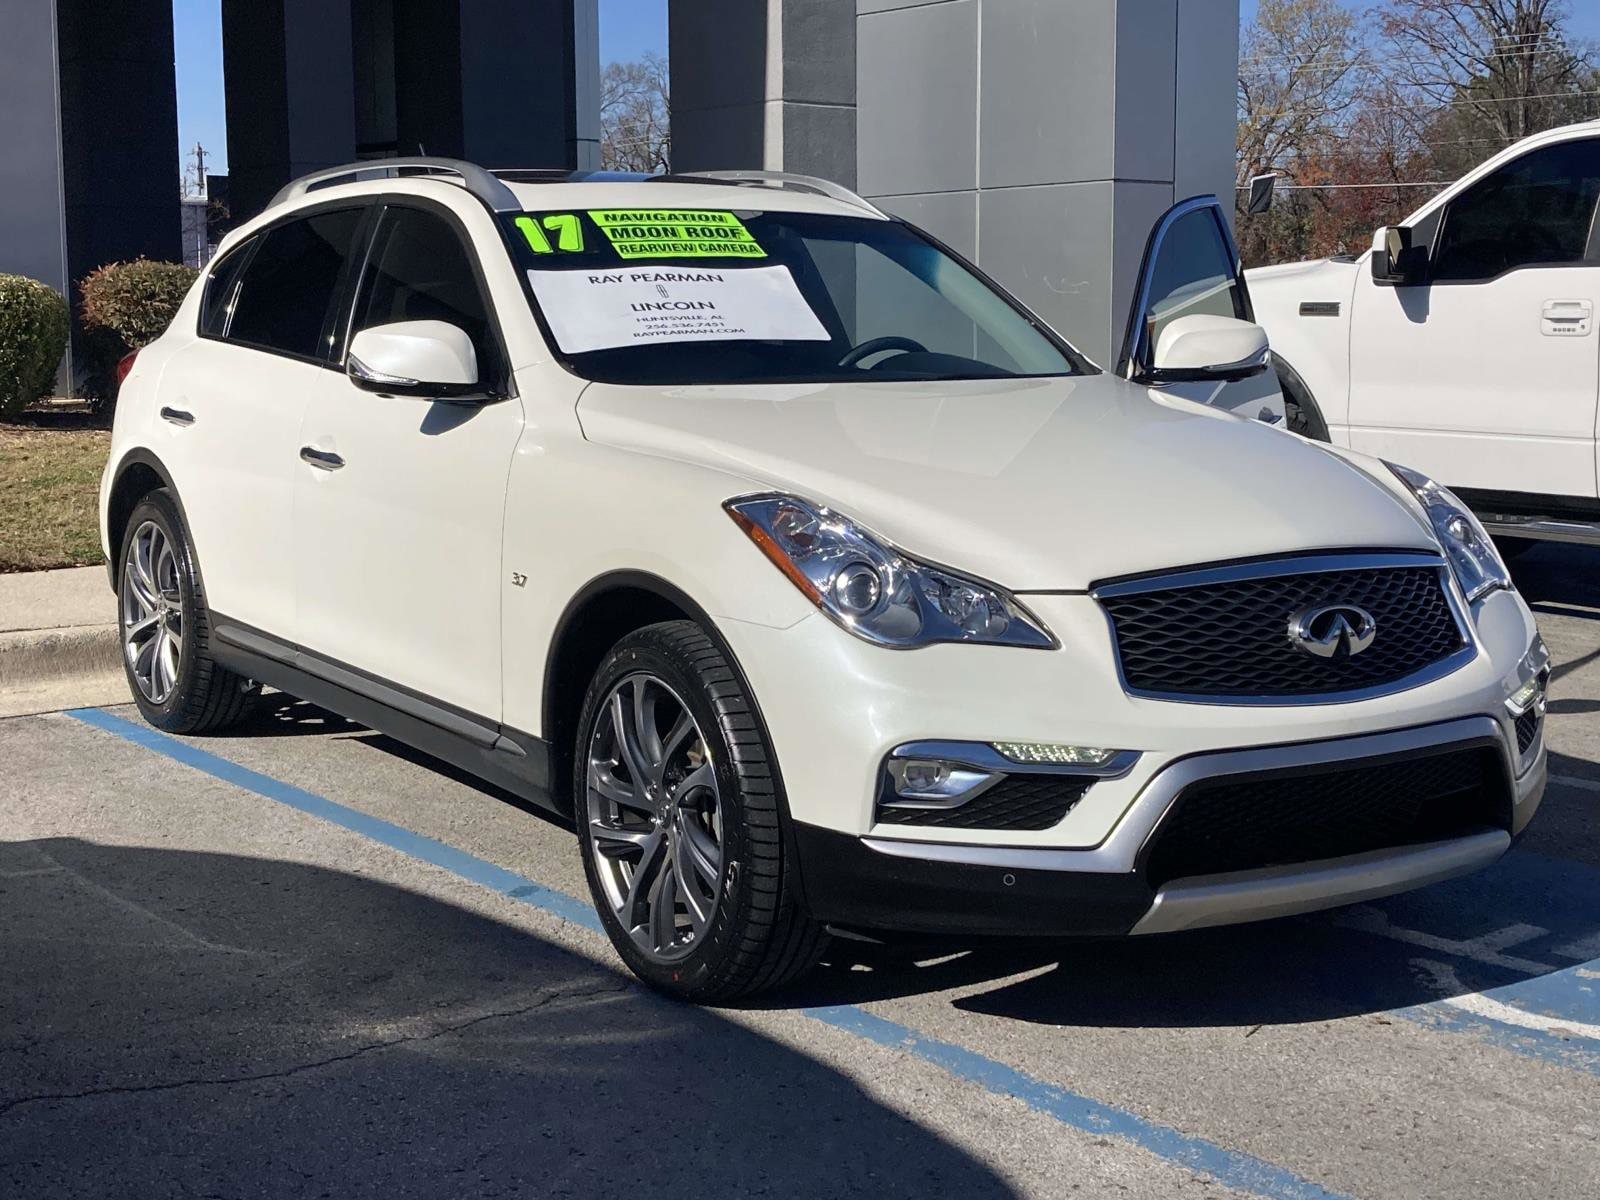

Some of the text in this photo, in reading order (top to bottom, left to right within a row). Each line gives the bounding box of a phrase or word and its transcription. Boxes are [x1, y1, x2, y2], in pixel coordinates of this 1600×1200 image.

[603, 212, 728, 223] NAVIGATION
[514, 214, 584, 254] 17
[610, 226, 744, 240] MOON ROOF
[618, 242, 760, 254] REARVIEW CAMERA
[588, 272, 725, 285] RAY PEARMAN
[631, 301, 716, 312] LINCOLN
[633, 327, 746, 338] RAYPEARMAN.COM
